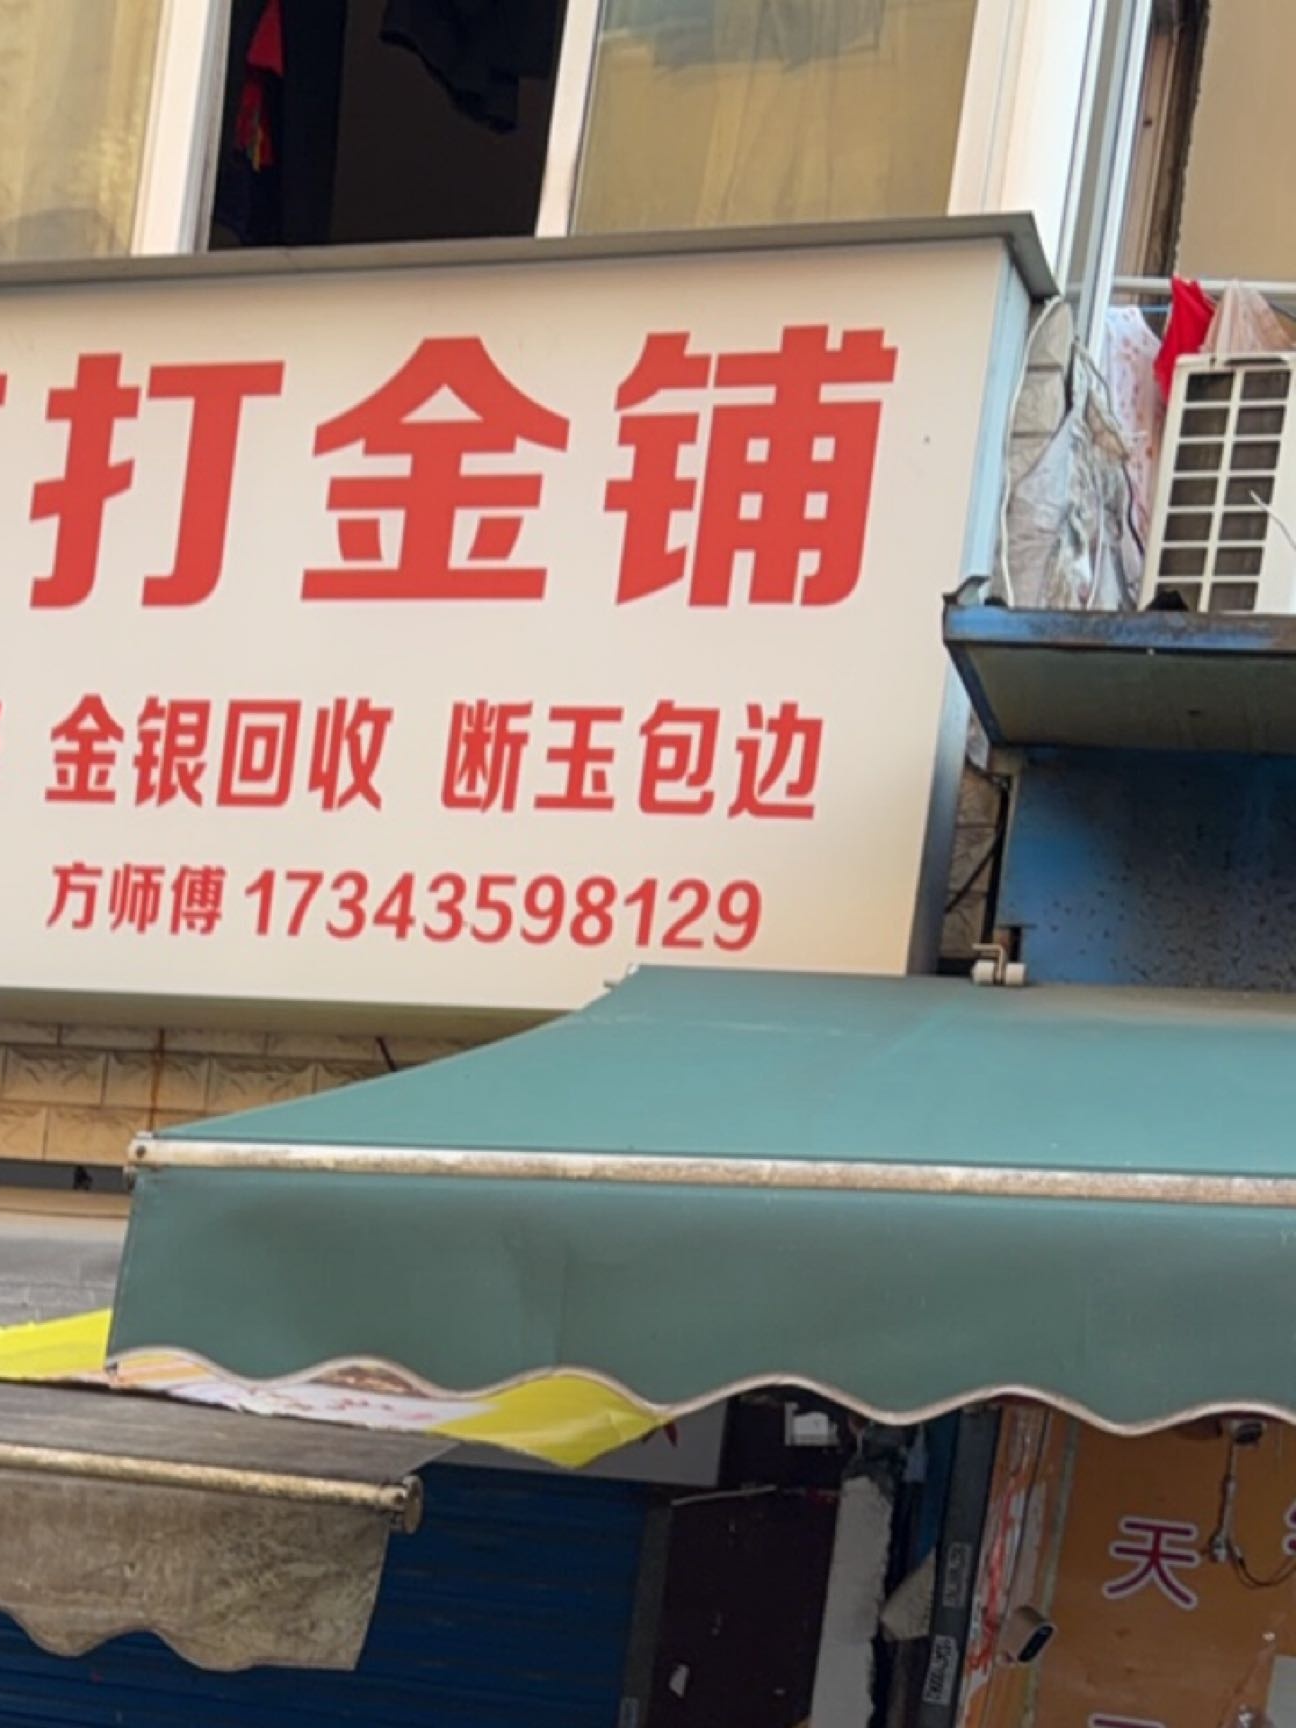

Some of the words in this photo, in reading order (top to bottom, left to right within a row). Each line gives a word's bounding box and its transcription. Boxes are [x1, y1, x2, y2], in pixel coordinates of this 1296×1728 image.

[45, 694, 394, 812] 金银回收
[441, 699, 825, 820] 断玉包边
[47, 862, 227, 935] 方师傅
[245, 869, 762, 952] 17343598129
